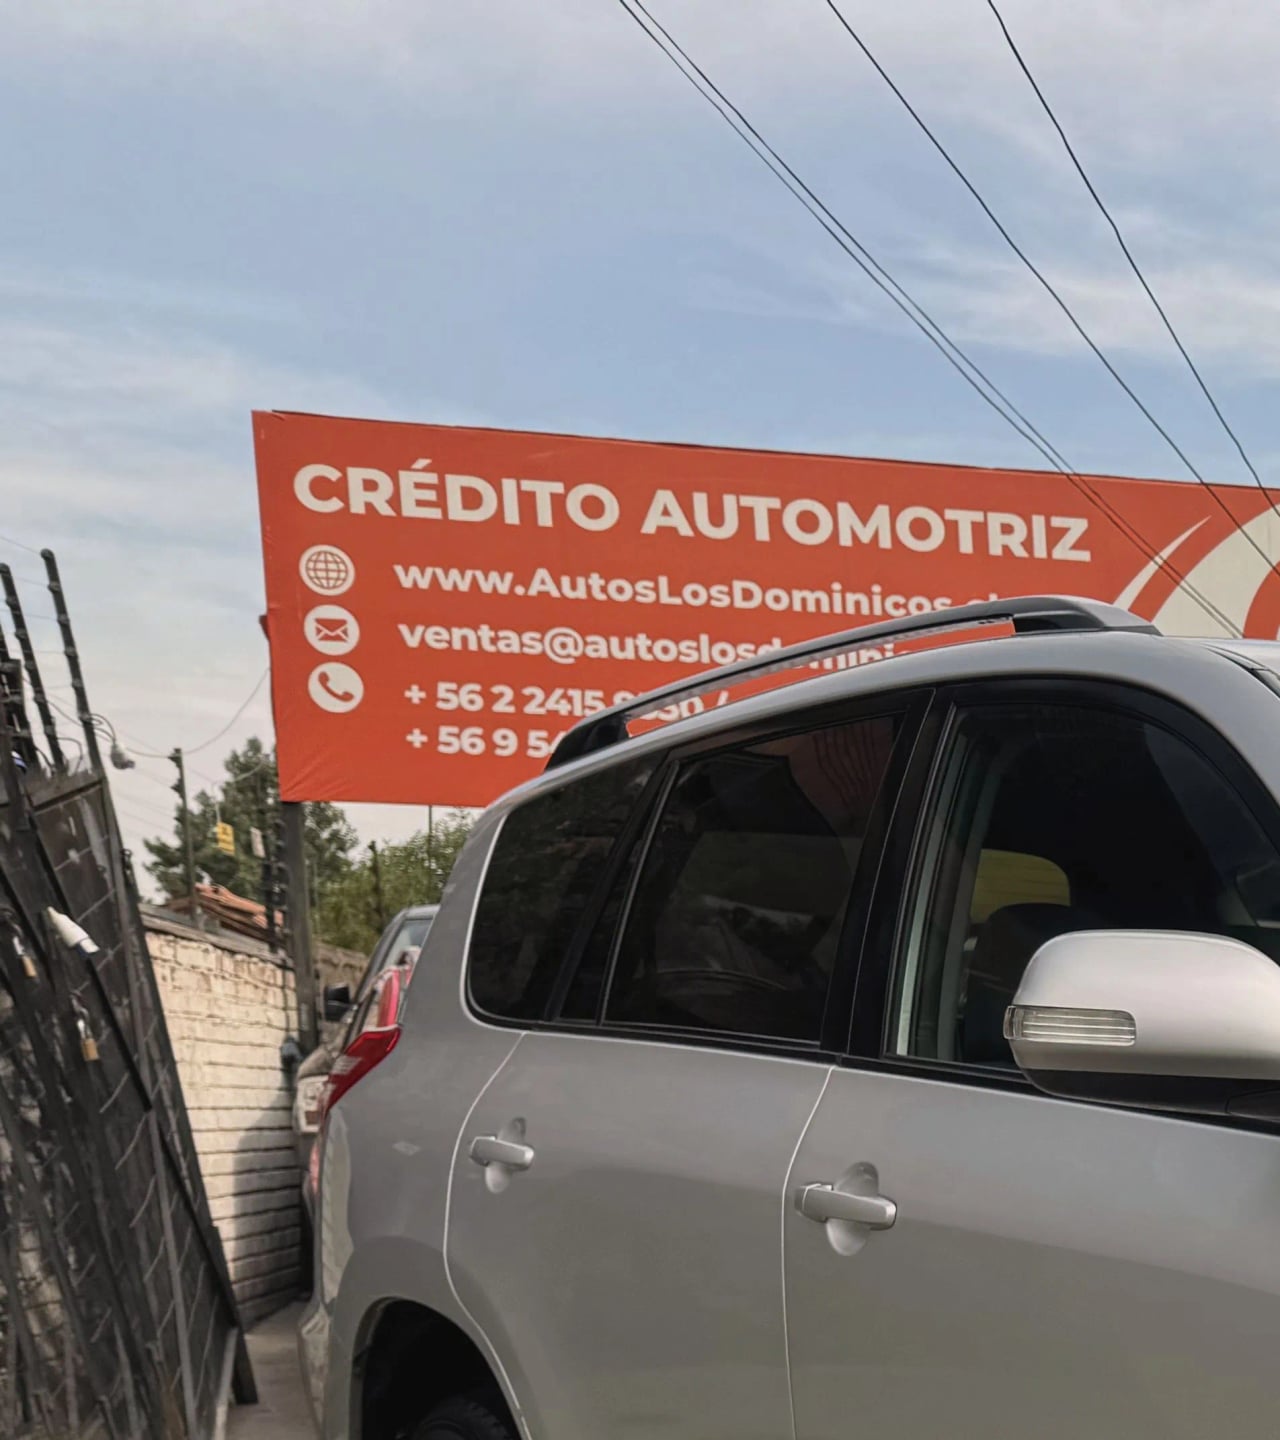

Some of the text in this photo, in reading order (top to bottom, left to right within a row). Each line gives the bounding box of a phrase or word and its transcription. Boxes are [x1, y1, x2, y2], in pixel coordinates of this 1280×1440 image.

[293, 458, 1091, 562] CRÉDITO AUTOMOTRIZ
[393, 564, 998, 617] www.AutosLosDominico
[436, 681, 484, 712] 56
[491, 684, 516, 714] 2
[522, 685, 607, 717] 2415
[437, 725, 486, 756] 56
[492, 727, 518, 758] 9
